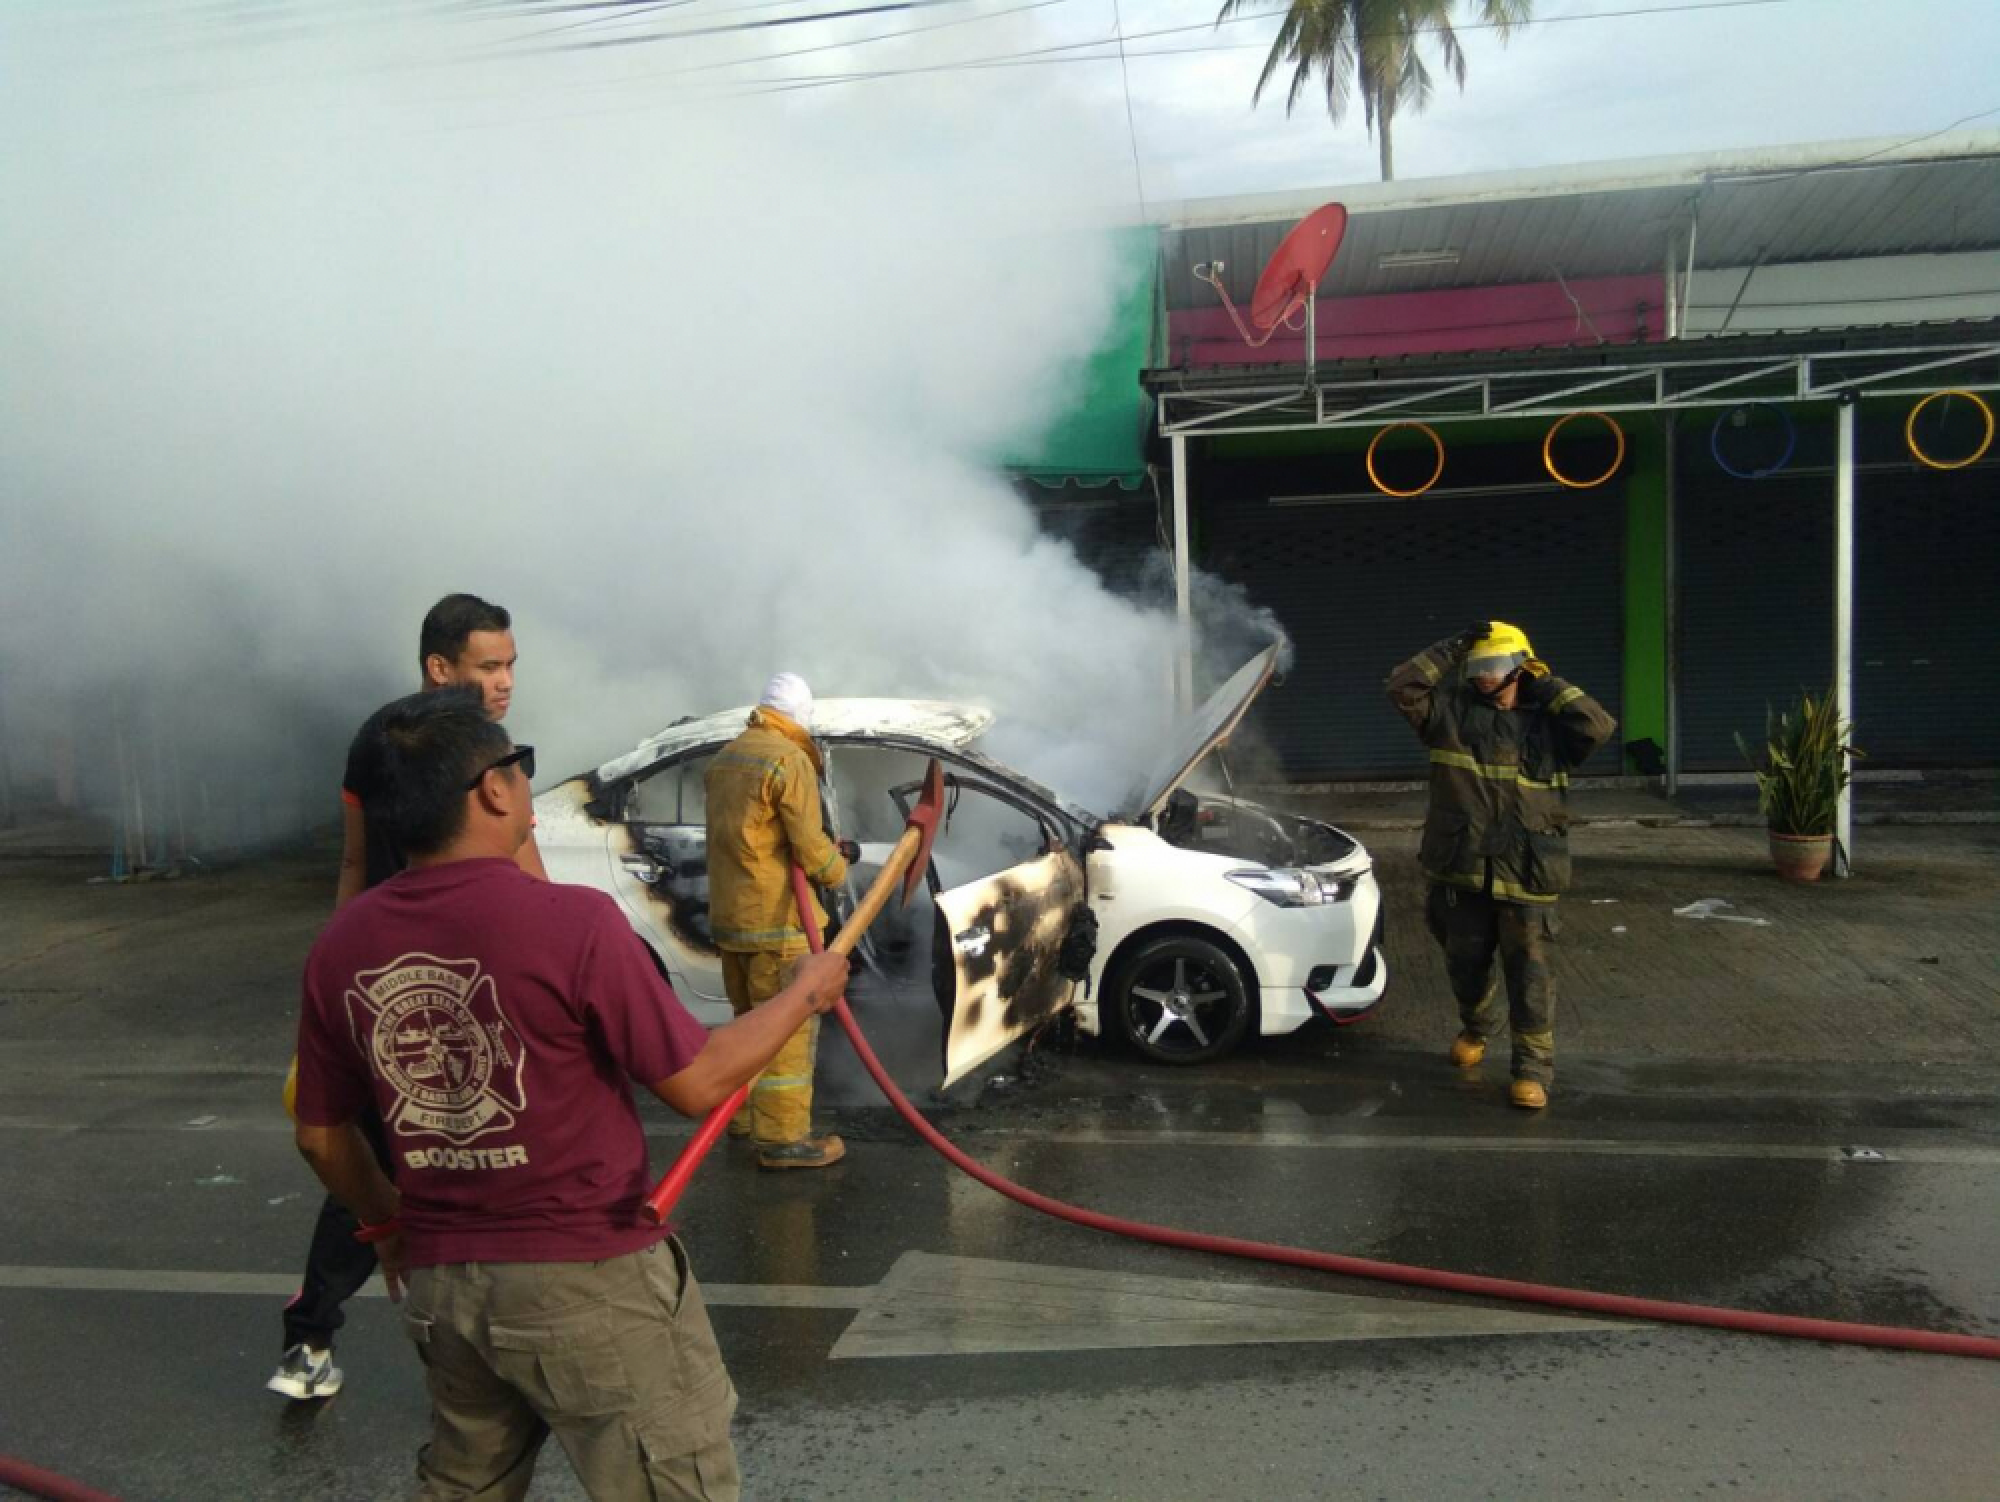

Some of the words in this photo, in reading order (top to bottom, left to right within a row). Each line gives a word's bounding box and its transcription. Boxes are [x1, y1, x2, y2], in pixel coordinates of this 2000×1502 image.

[373, 968, 423, 998] MIDDLE
[427, 969, 463, 991] BASS
[404, 1144, 528, 1171] BOOSTER
